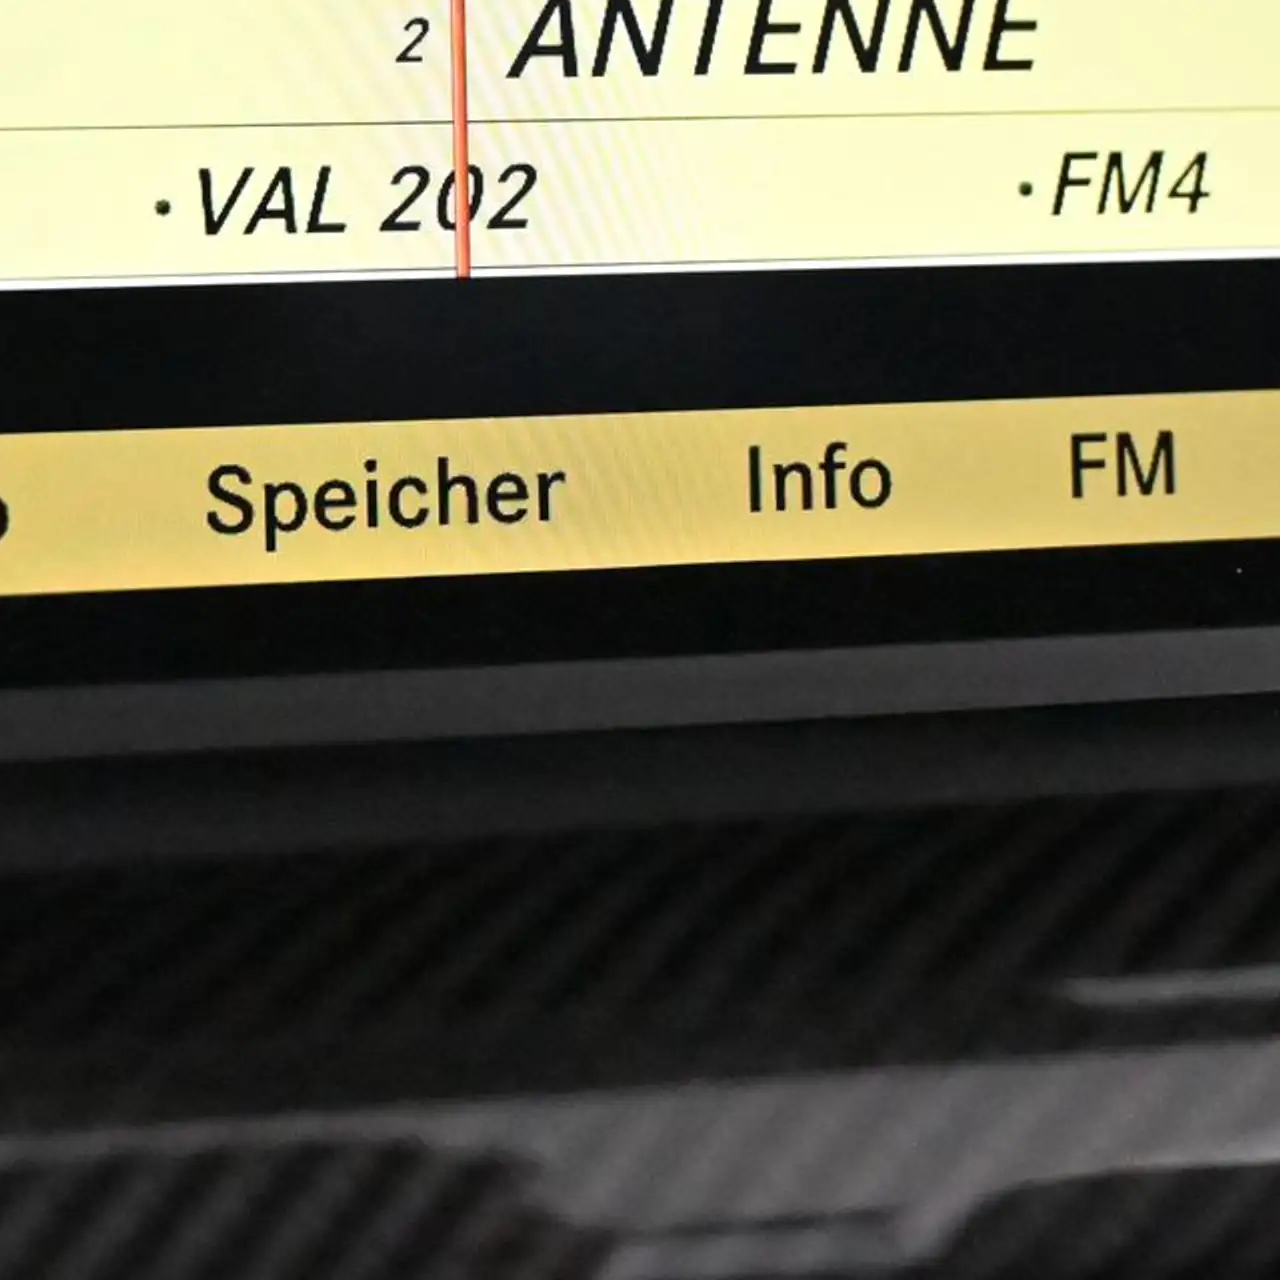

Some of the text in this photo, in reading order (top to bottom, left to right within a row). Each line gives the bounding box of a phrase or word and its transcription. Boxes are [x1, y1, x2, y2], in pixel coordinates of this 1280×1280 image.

[395, 16, 430, 63] 2
[197, 162, 538, 236] VAL 202
[1051, 150, 1211, 216] FM4
[748, 441, 893, 513] Info
[1070, 430, 1177, 499] FM
[206, 456, 566, 553] Speicher
